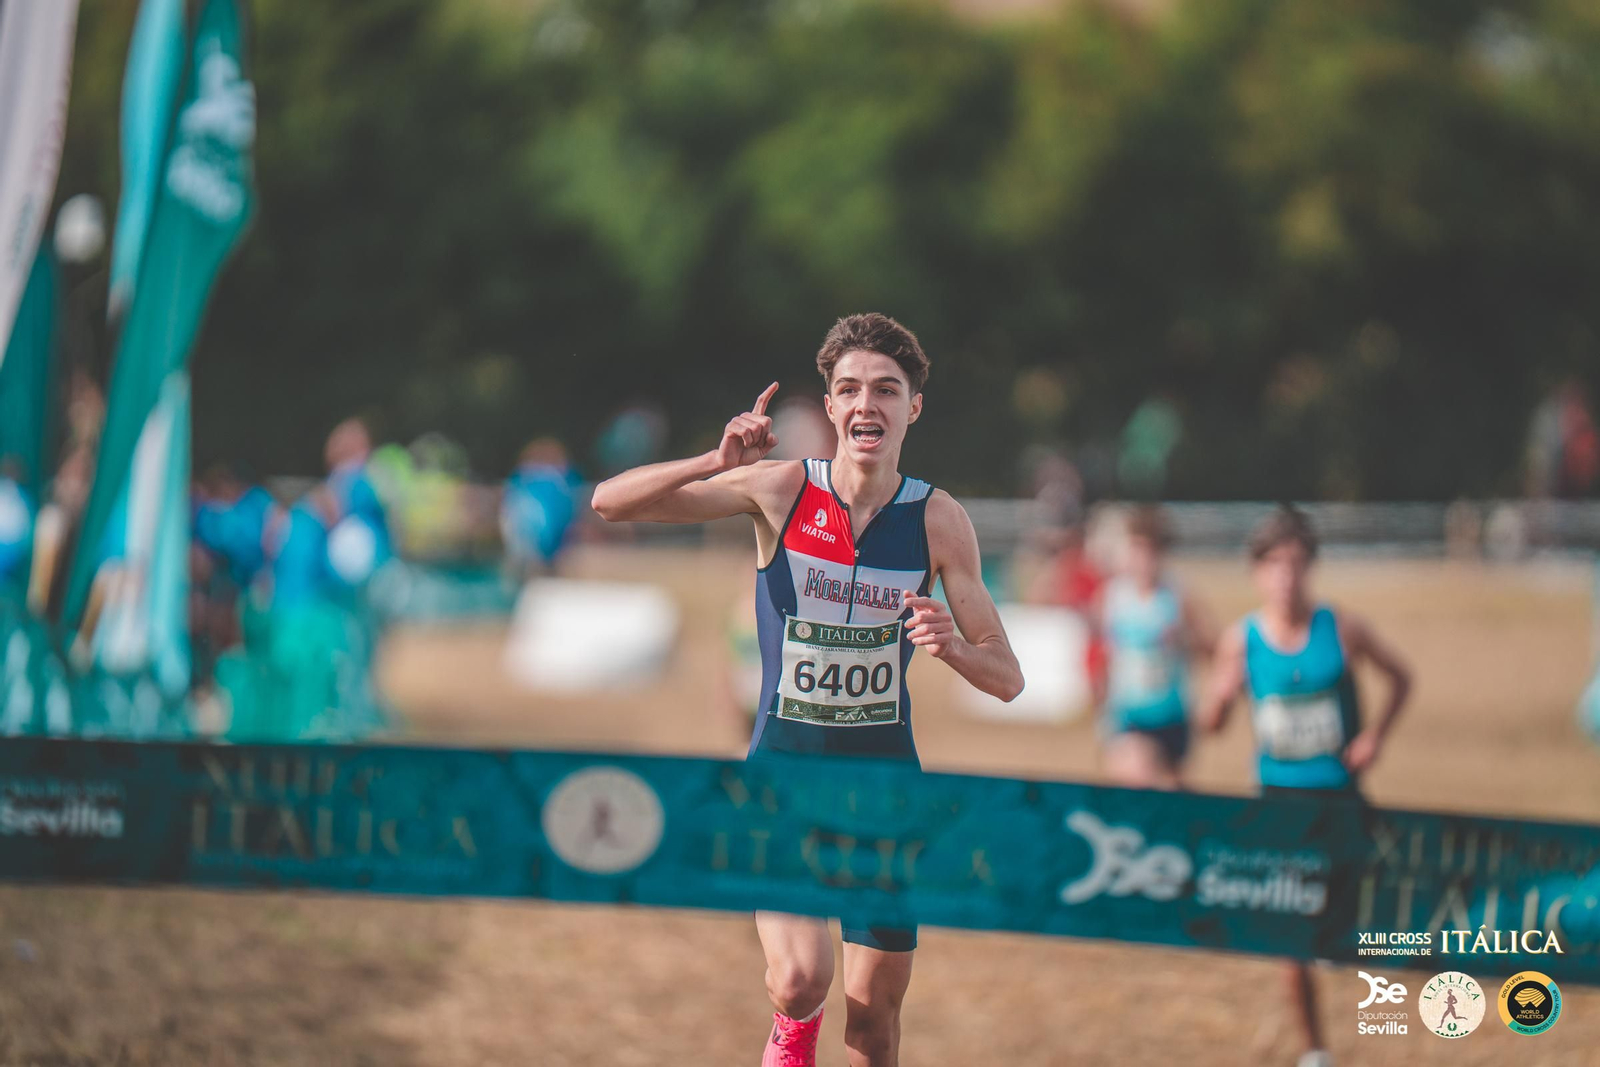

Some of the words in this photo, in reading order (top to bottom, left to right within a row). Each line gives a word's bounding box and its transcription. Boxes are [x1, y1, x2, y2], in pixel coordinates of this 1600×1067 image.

[801, 523, 836, 543] VIATOR
[819, 627, 875, 641] ITÁLICA
[794, 660, 893, 698] 6400
